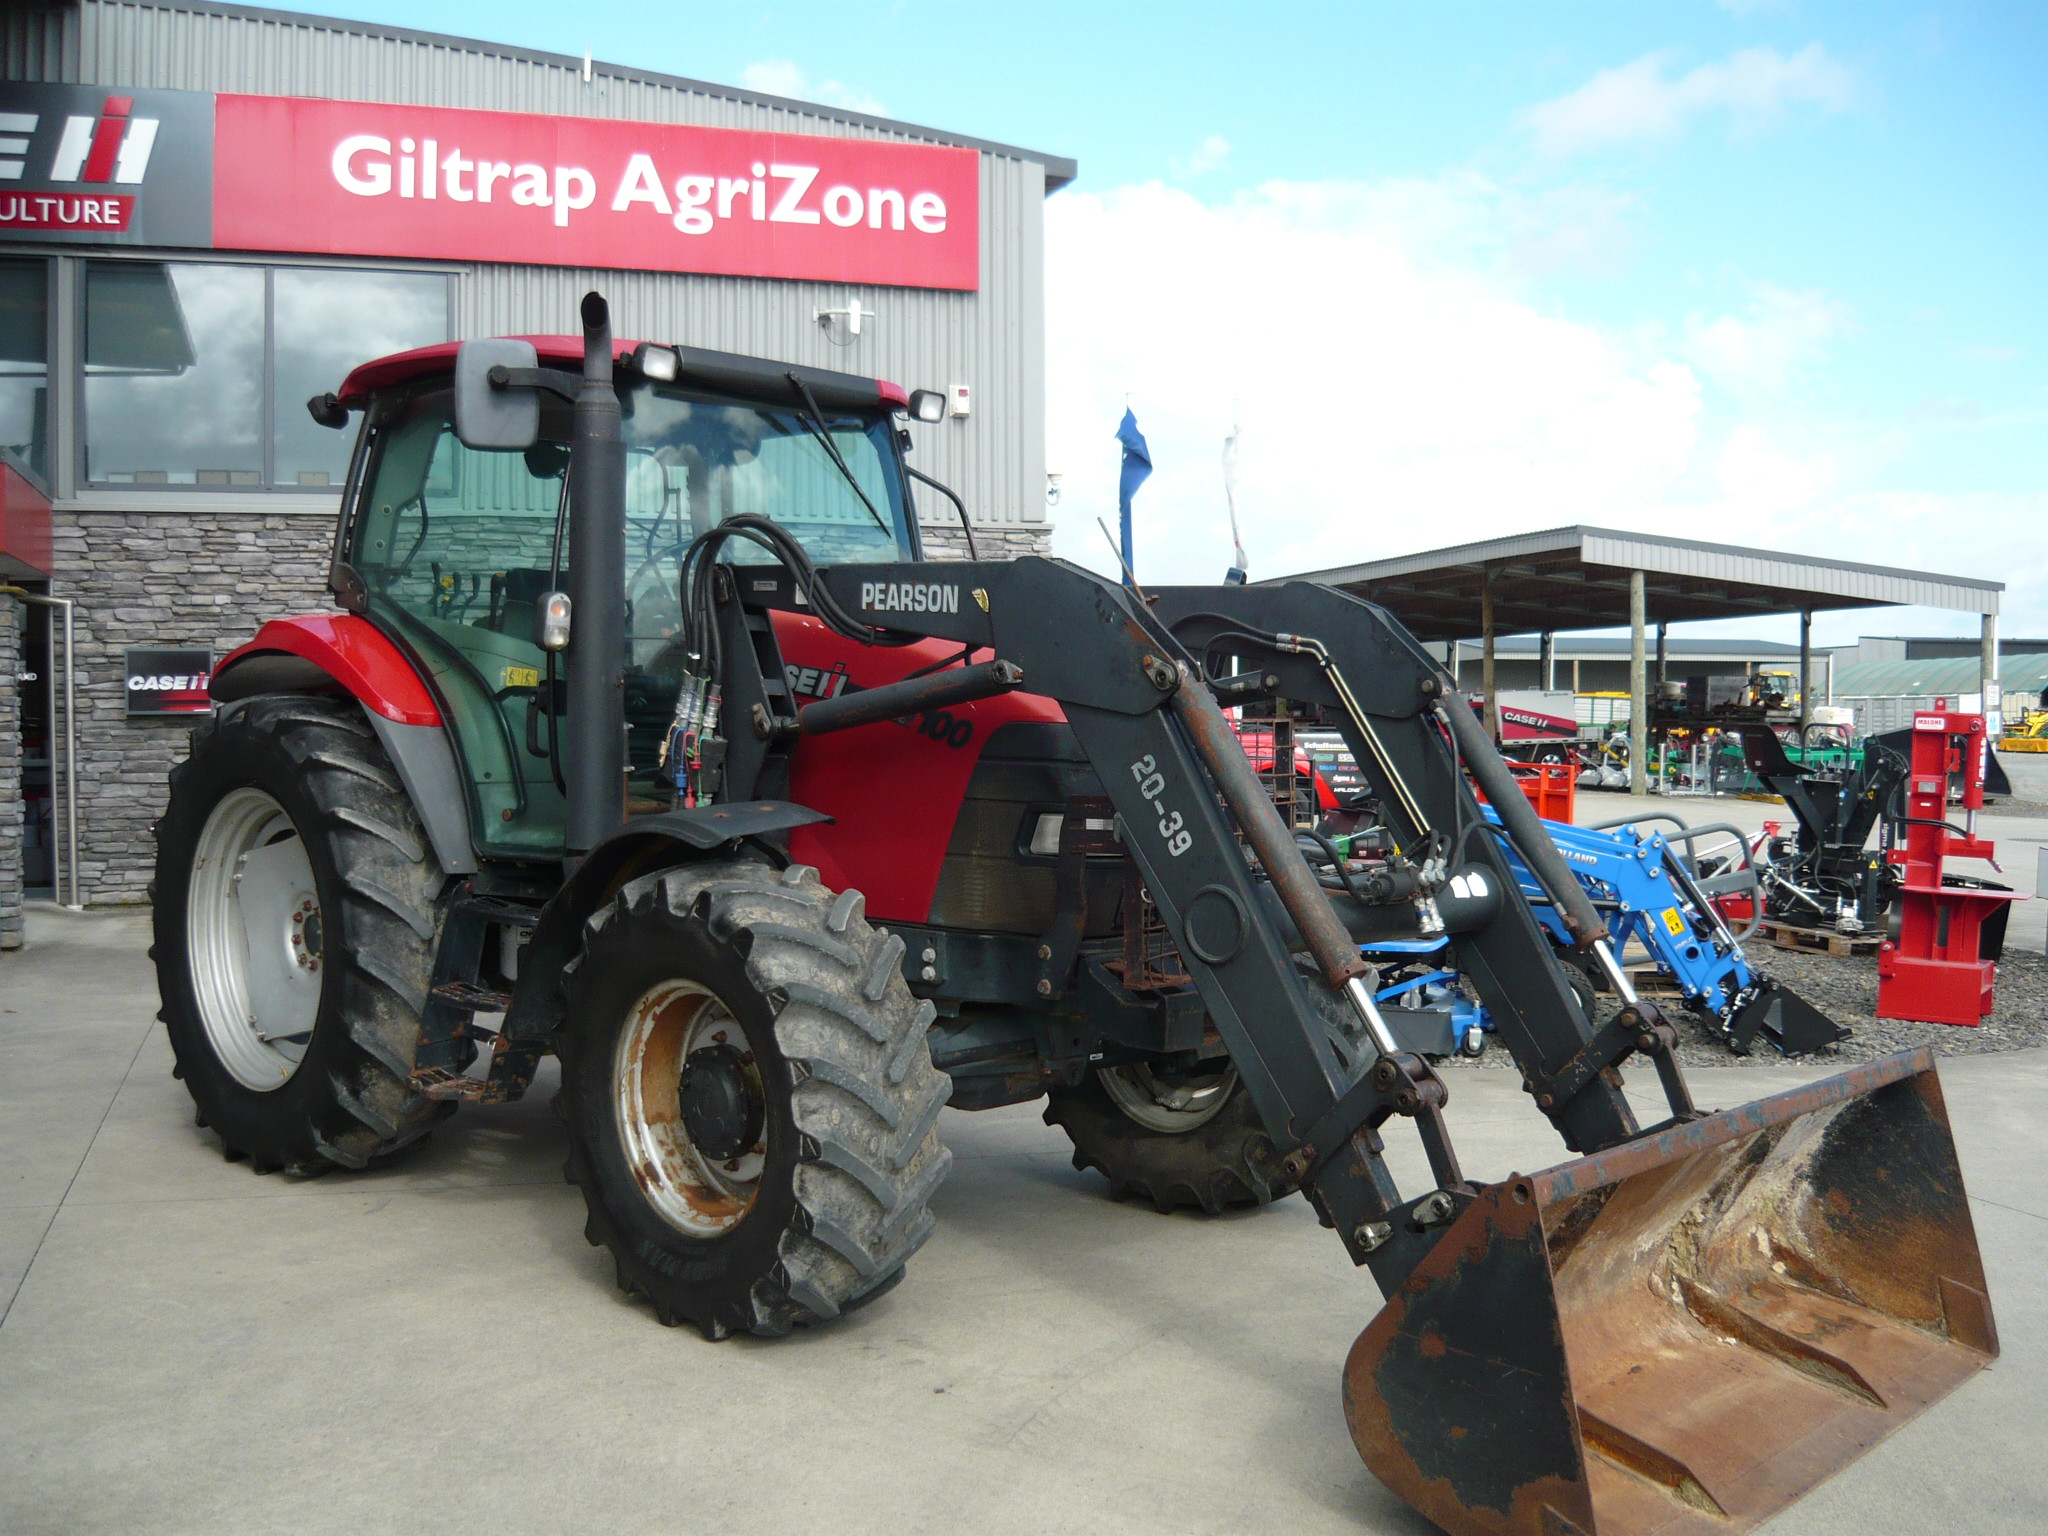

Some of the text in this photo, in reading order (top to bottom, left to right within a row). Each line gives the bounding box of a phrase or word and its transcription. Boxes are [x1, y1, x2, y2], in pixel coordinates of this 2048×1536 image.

[332, 135, 947, 235] Giltrap AgriZone
[861, 583, 959, 614] PEARSON
[128, 675, 189, 690] CASE
[1504, 712, 1537, 725] CASE
[1130, 753, 1193, 857] 20-39
